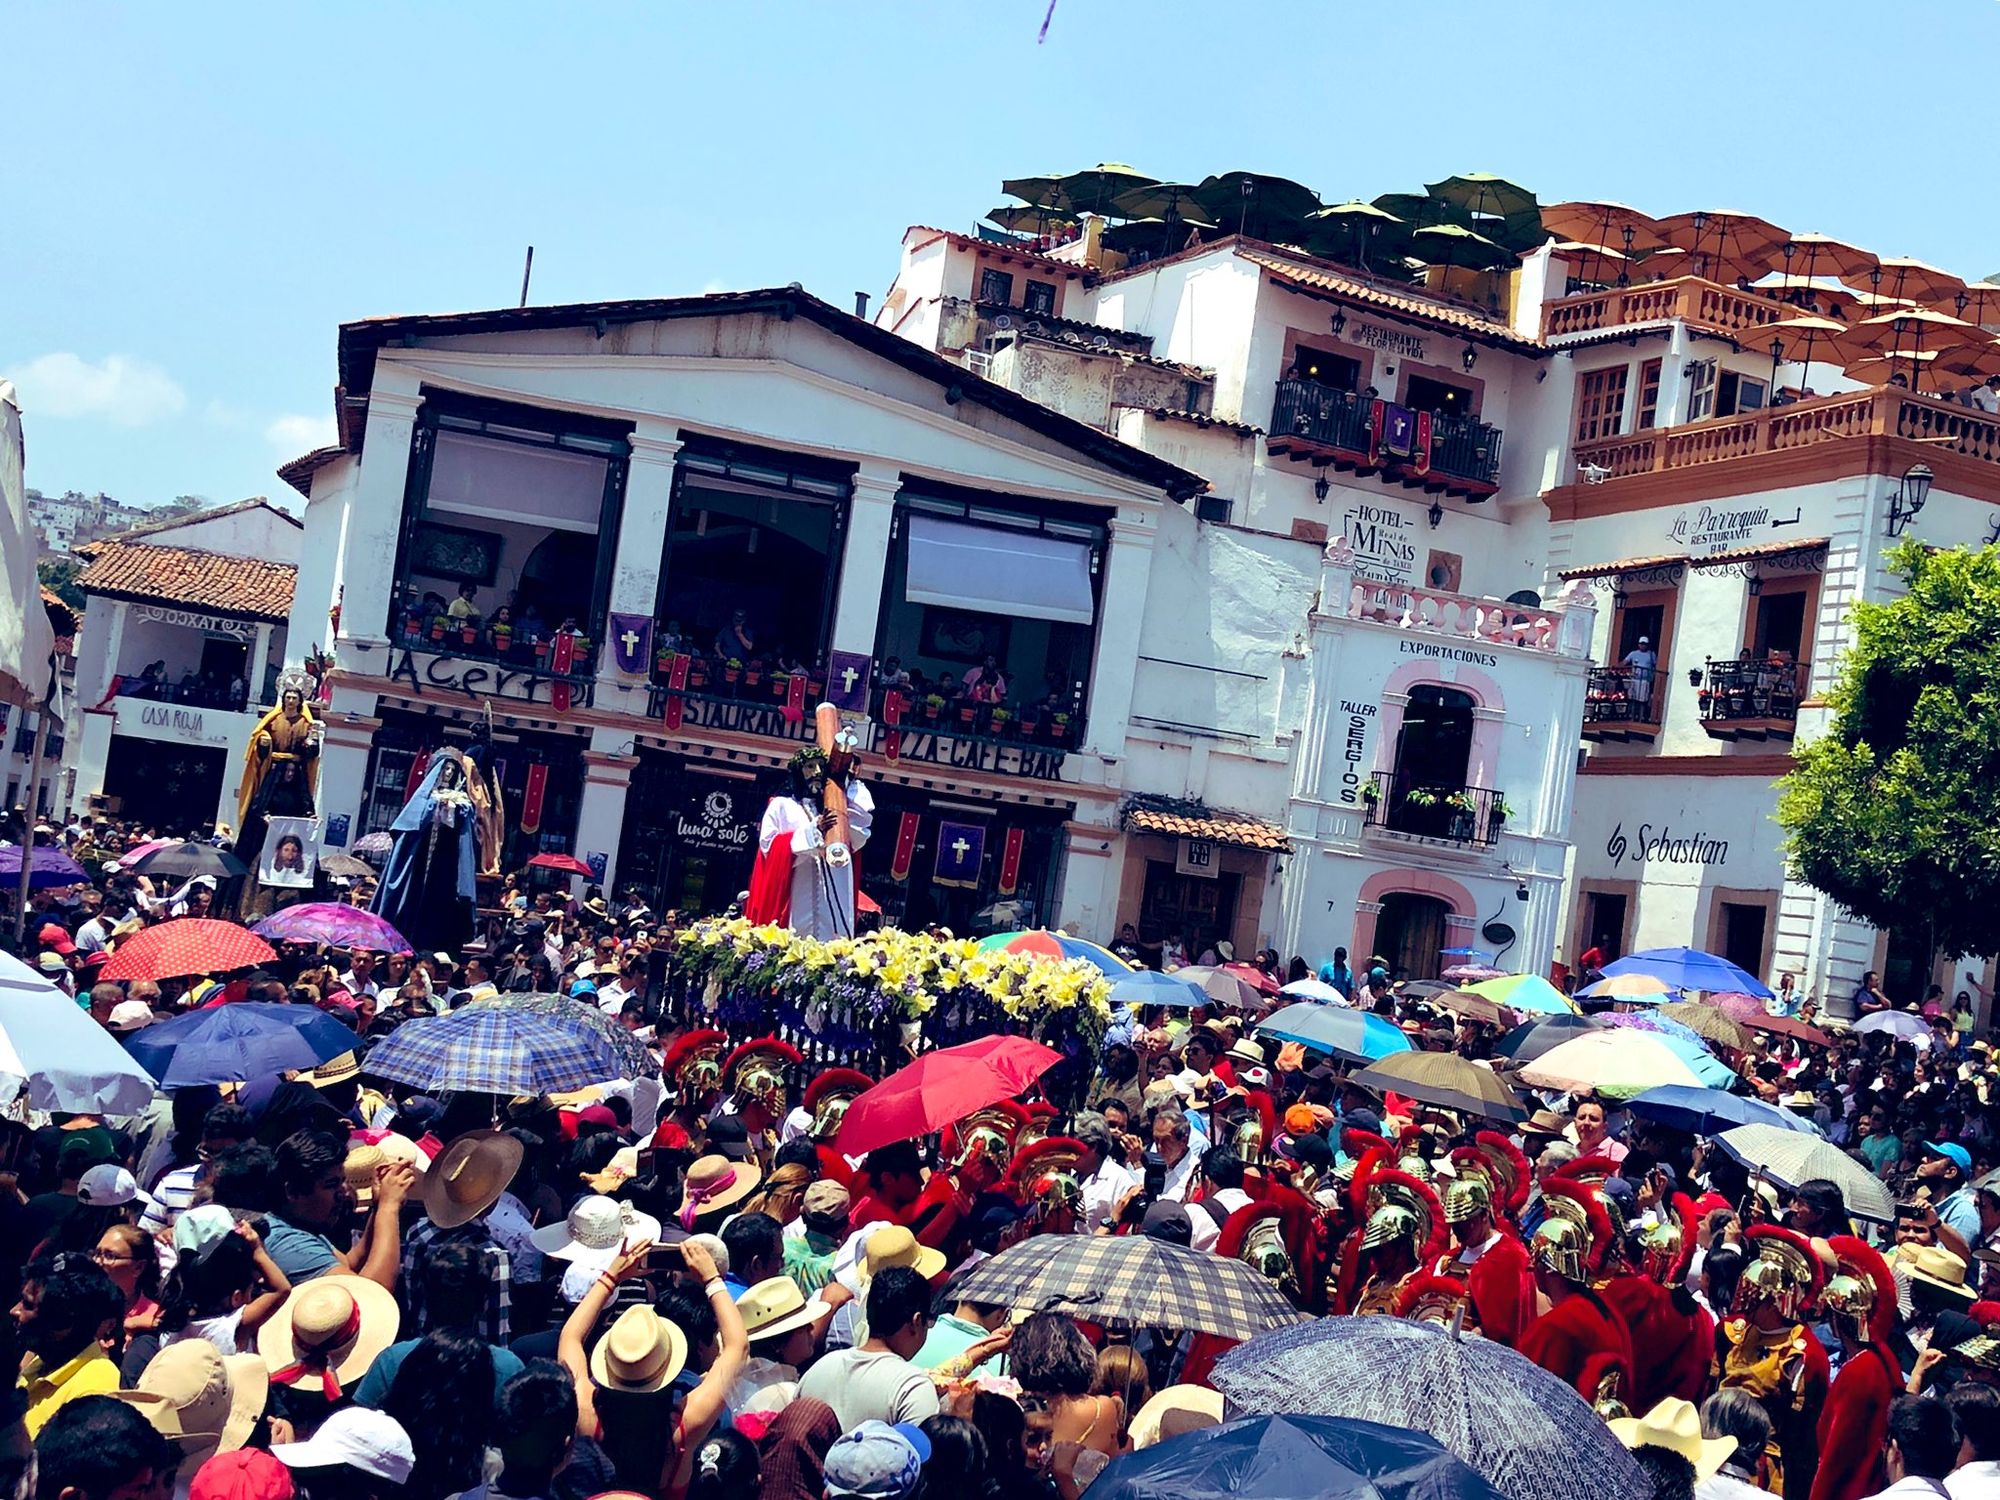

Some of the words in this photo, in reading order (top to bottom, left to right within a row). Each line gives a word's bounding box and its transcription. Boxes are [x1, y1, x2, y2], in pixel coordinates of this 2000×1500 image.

[1361, 324, 1423, 349] RESTAURANTE
[1359, 505, 1404, 528] HOTEL
[1665, 511, 1688, 545] La
[1690, 505, 1769, 534] Parroquia
[1691, 528, 1752, 545] RESTAURANTE
[1710, 543, 1728, 554] BAR
[1400, 640, 1497, 667] EXPORTACIONES
[142, 706, 170, 727] CASA
[173, 710, 203, 731] ROJA
[1340, 700, 1377, 717] TALLER
[677, 816, 714, 838] luna
[718, 824, 749, 843] solé
[1631, 823, 1728, 865] Sebastian
[1327, 900, 1334, 912] 7
